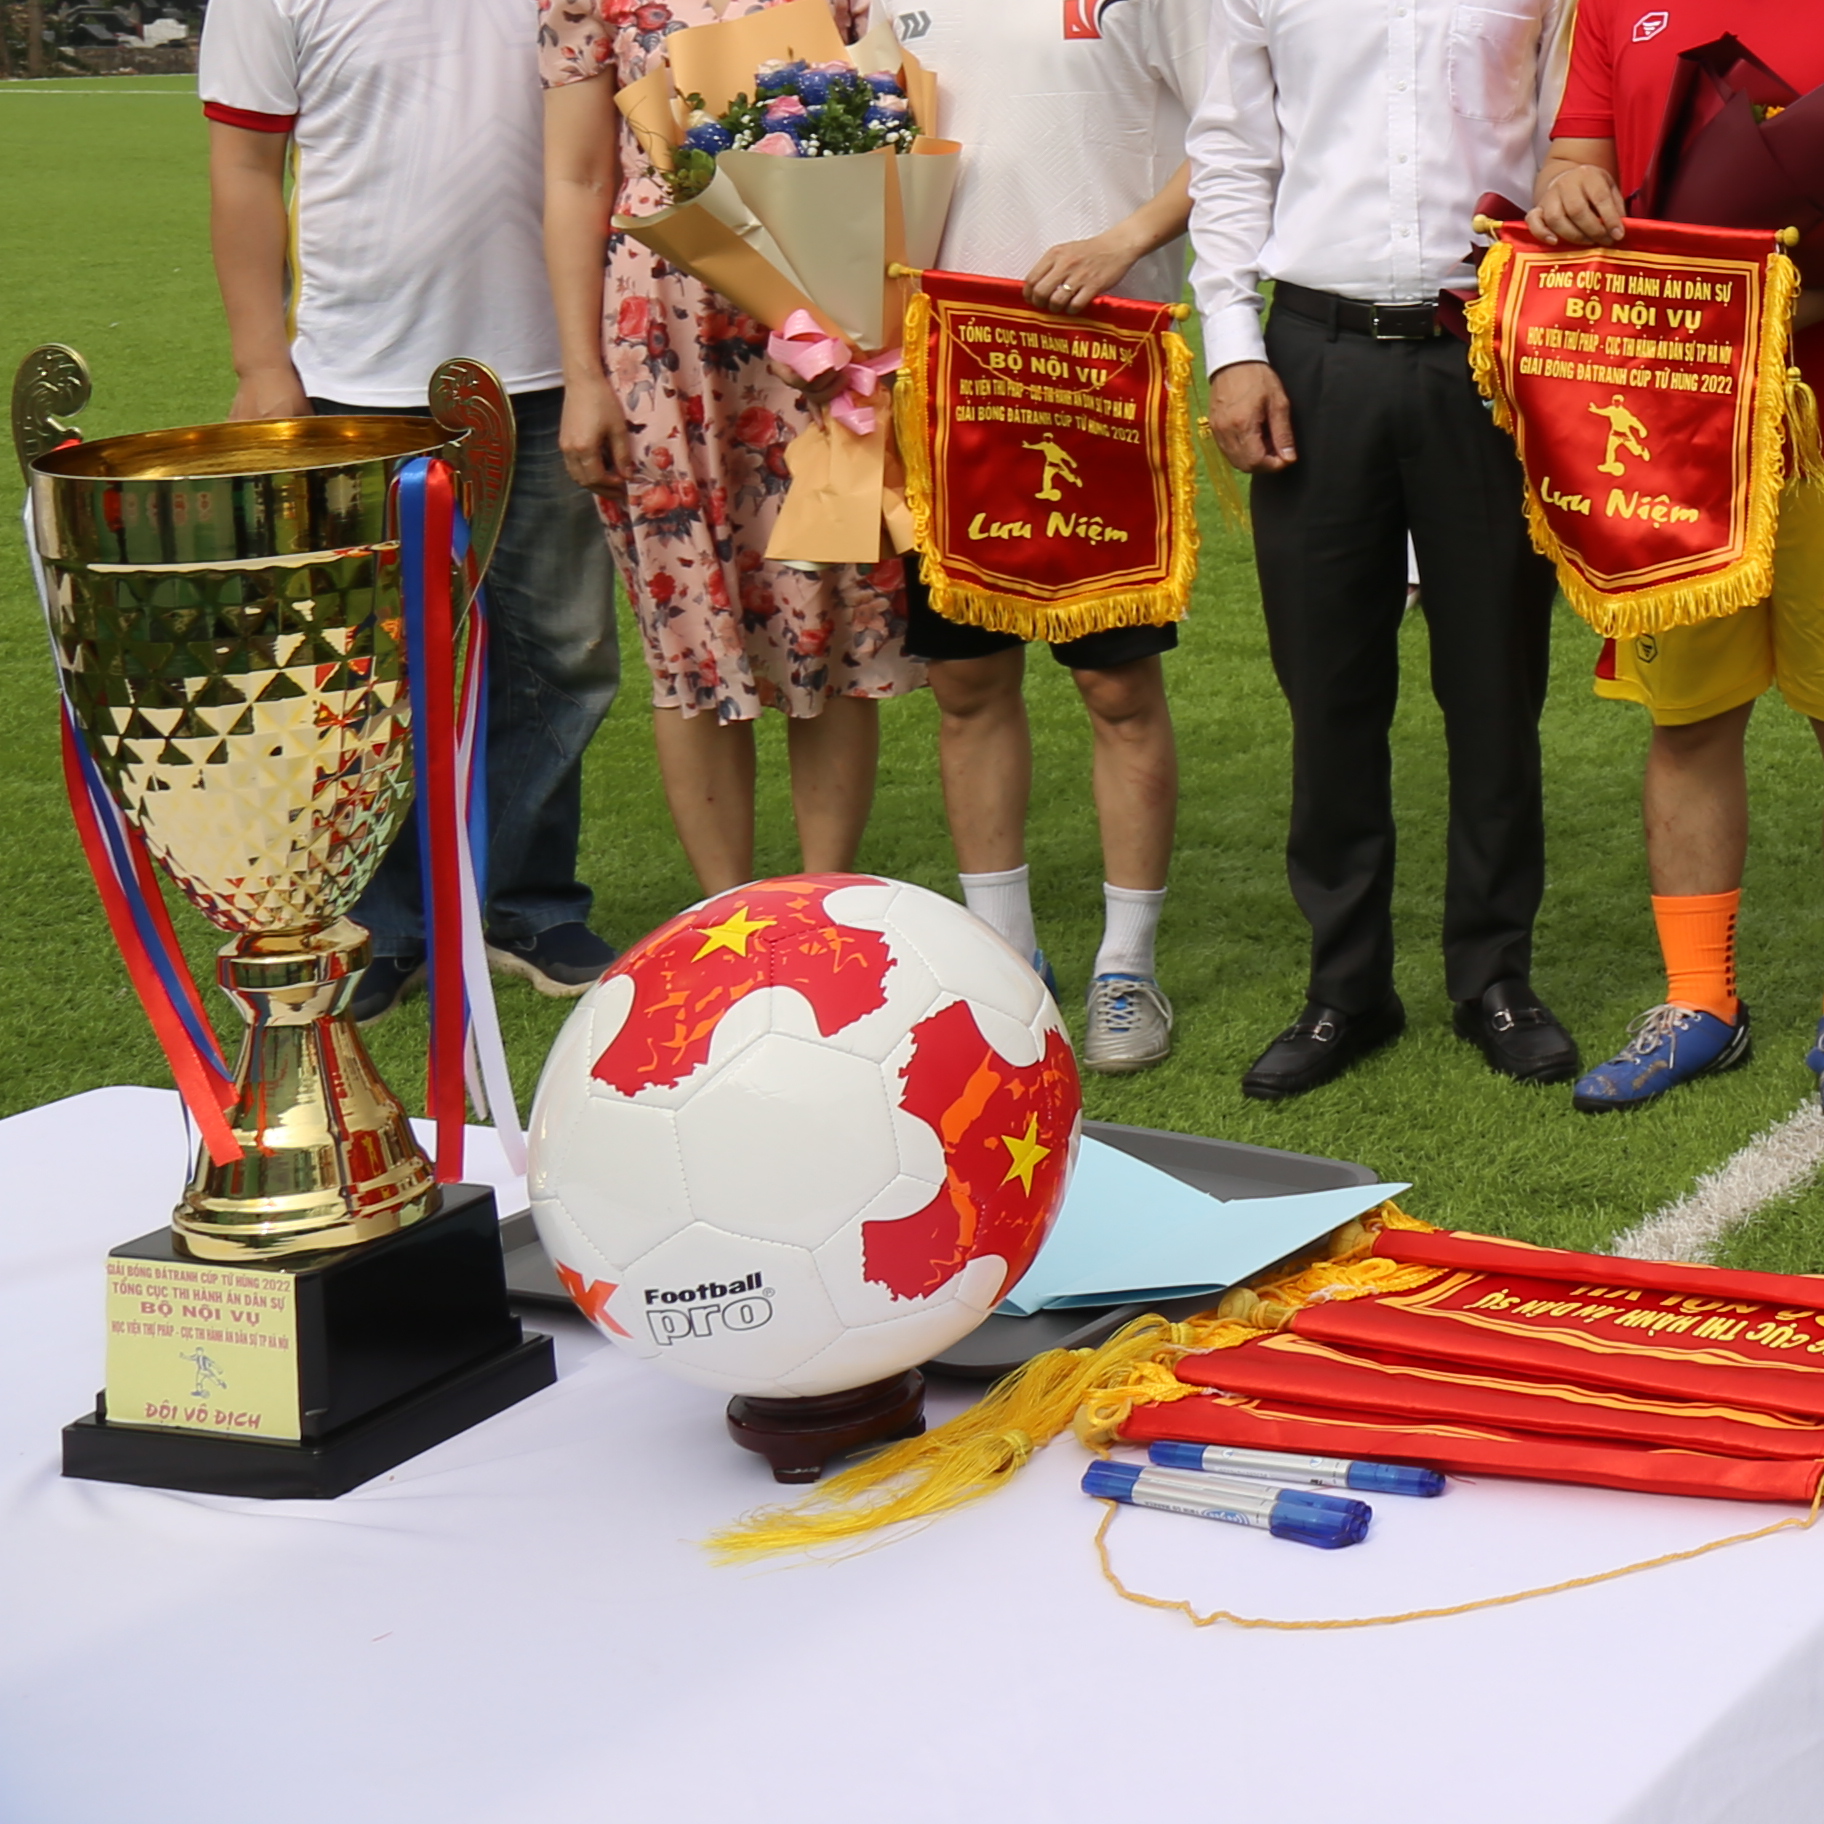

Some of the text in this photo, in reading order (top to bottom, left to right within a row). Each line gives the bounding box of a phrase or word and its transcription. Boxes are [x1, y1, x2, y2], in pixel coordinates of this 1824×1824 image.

[1539, 265, 1733, 307] TỔNG CỤC THI HÀNH ÁN DÂN SỰ
[1565, 296, 1702, 334] BỘ NỘI VỤ
[958, 317, 992, 343] TỔNG
[995, 327, 1018, 348] CỤC
[1019, 331, 1039, 348] THI
[1040, 332, 1069, 354] HÀNH
[1071, 335, 1089, 358] ÁN
[1091, 338, 1117, 361] DÂN
[989, 349, 1107, 391] BỘ NỘI VỤ
[1519, 350, 1543, 375] GIẢI
[1544, 355, 1575, 379] BÓNG
[1629, 364, 1652, 387] CÚP
[1670, 367, 1699, 391] HÙNG
[1700, 374, 1733, 395] 2022
[977, 401, 1006, 422] BÓNG
[1111, 426, 1141, 444] 2022
[1540, 476, 1700, 528] Lưu Niệm
[968, 512, 1128, 545] Lưu Niệm
[112, 1277, 286, 1312] TỔNG CỤC THI HÀNH ÁN DÂN SỰ
[127, 1264, 152, 1278] BÓNG
[200, 1271, 218, 1284] CÚP
[262, 1278, 291, 1292] 2022
[645, 1271, 762, 1305] Football
[141, 1300, 260, 1327] BỘ NỘI VỤ
[1463, 1288, 1521, 1310] SỰ
[1511, 1299, 1583, 1317] DÂN
[1574, 1303, 1626, 1323] ÁN
[646, 1296, 773, 1345] pro
[1614, 1309, 1703, 1336] HÀNH
[1691, 1316, 1749, 1341] THI
[1745, 1322, 1811, 1349] CỤC
[144, 1399, 261, 1430] ĐỘI VÔ ĐỊCH
